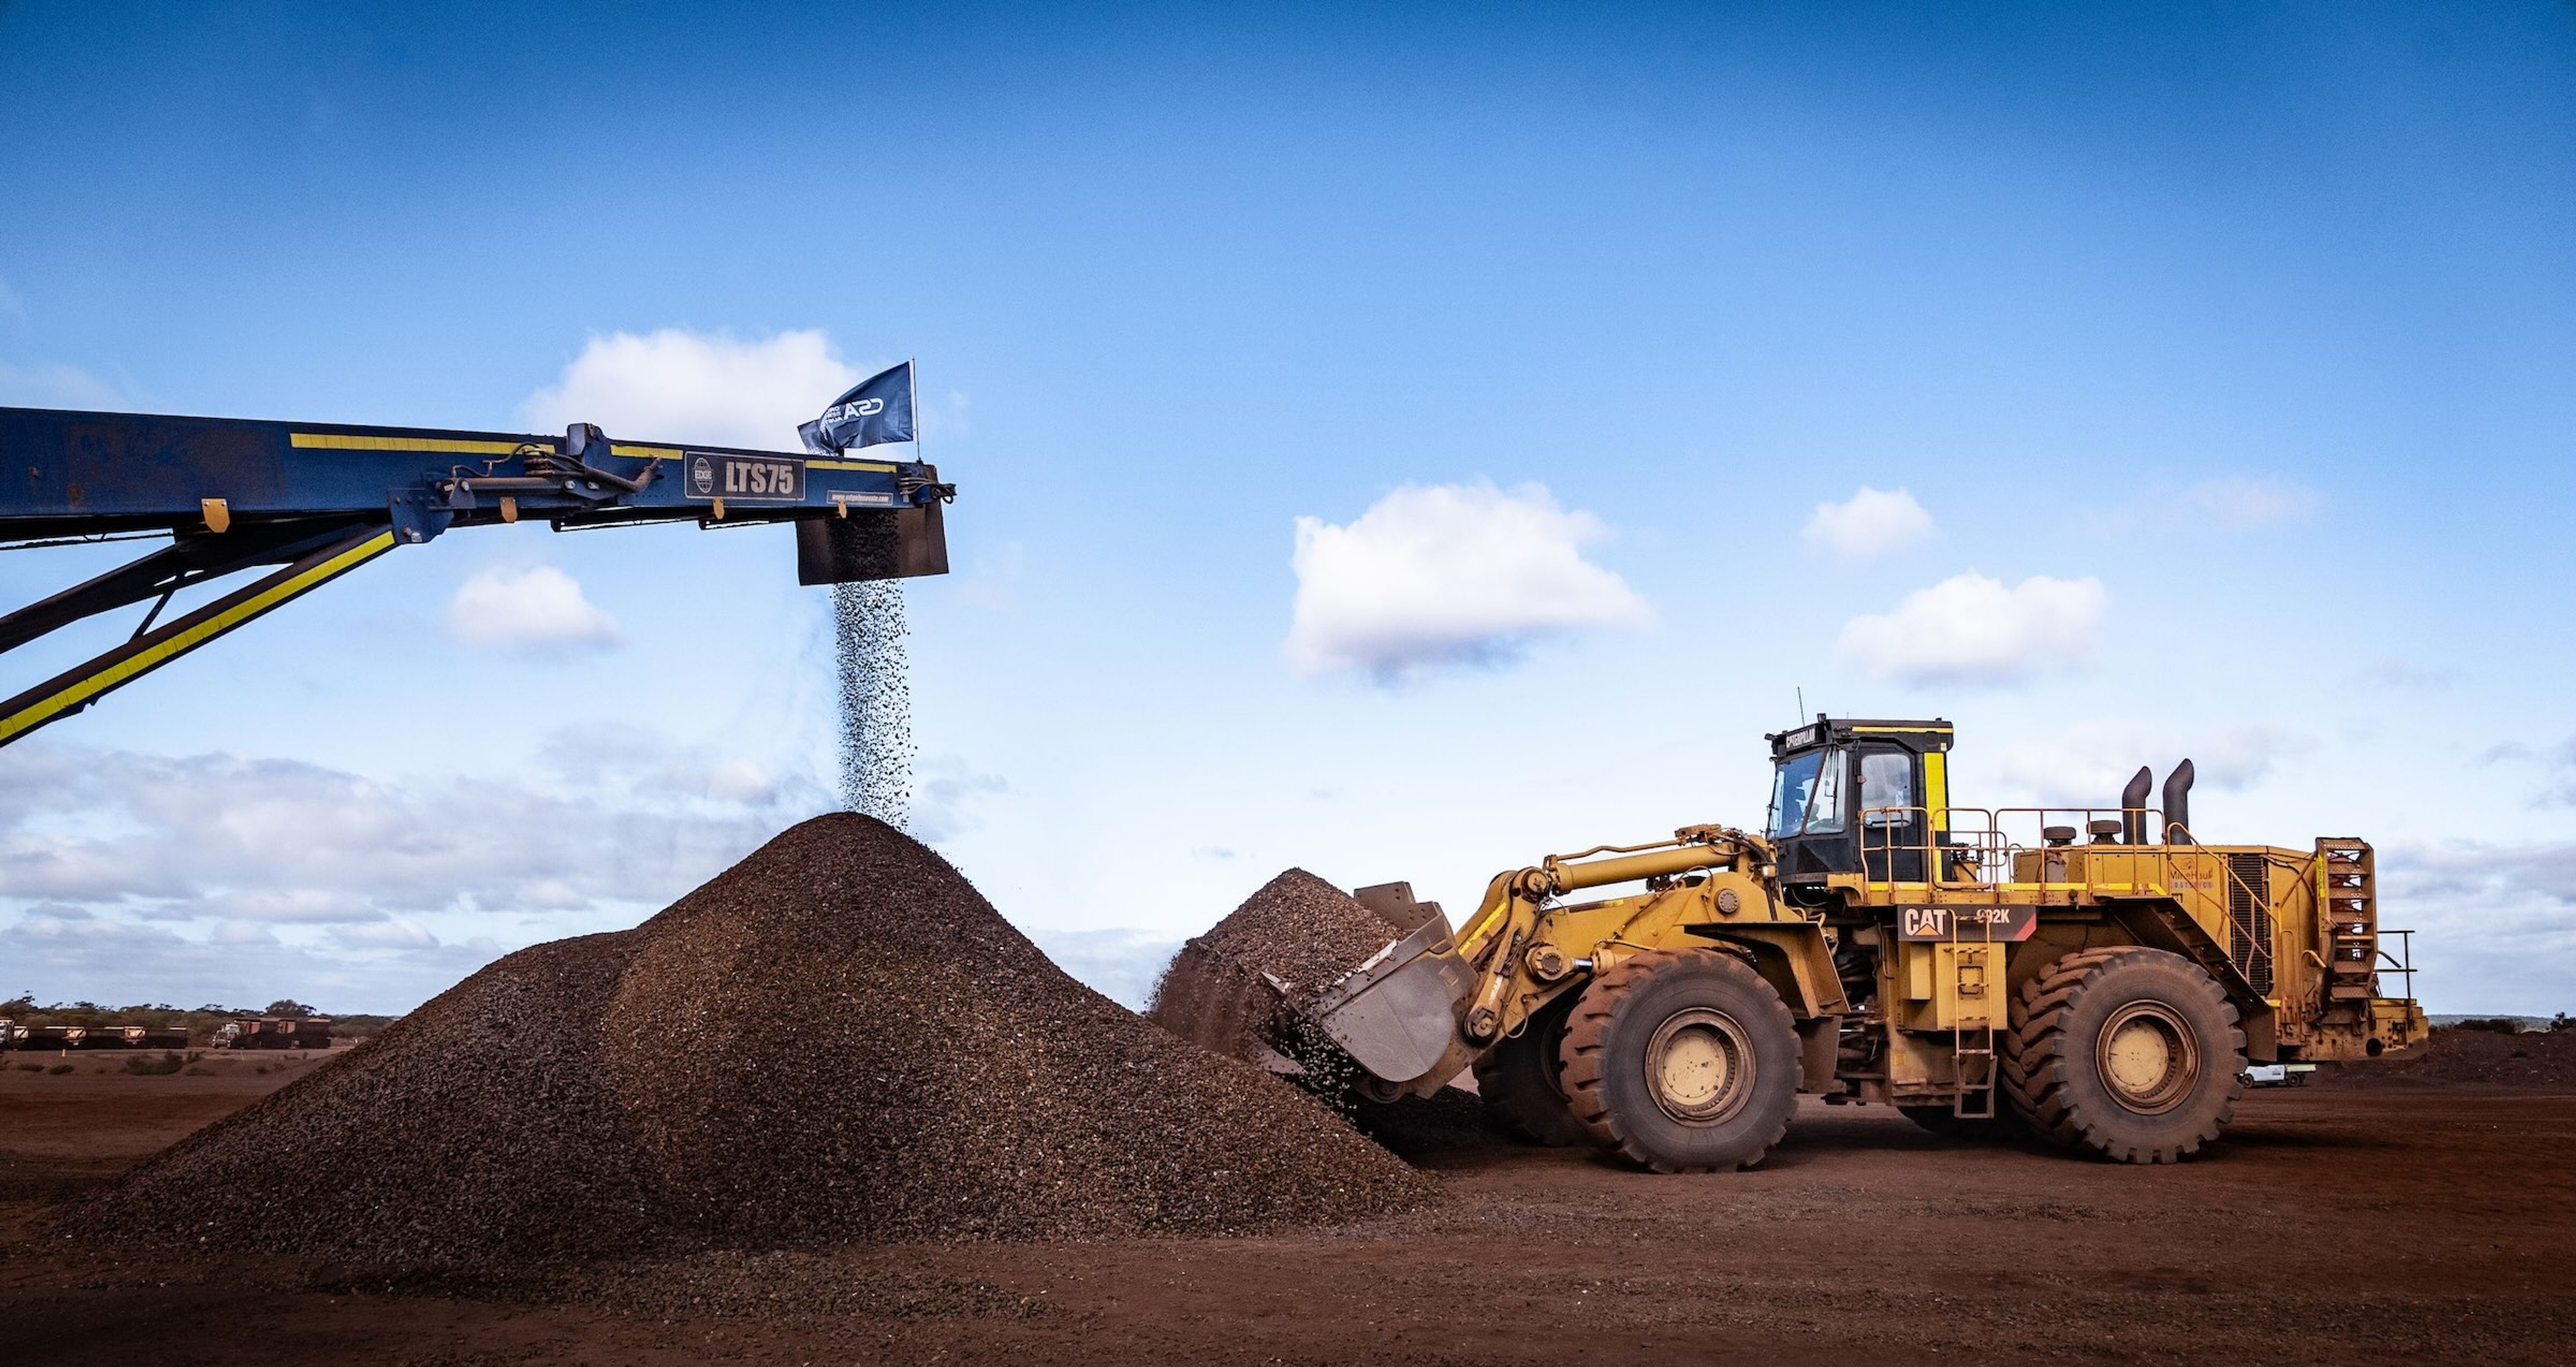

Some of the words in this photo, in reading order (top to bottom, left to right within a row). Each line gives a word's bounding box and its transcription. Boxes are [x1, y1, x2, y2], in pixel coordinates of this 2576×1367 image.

[694, 470, 712, 480] EDGE
[725, 461, 794, 494] LTS75
[1904, 908, 1947, 936] CAT
